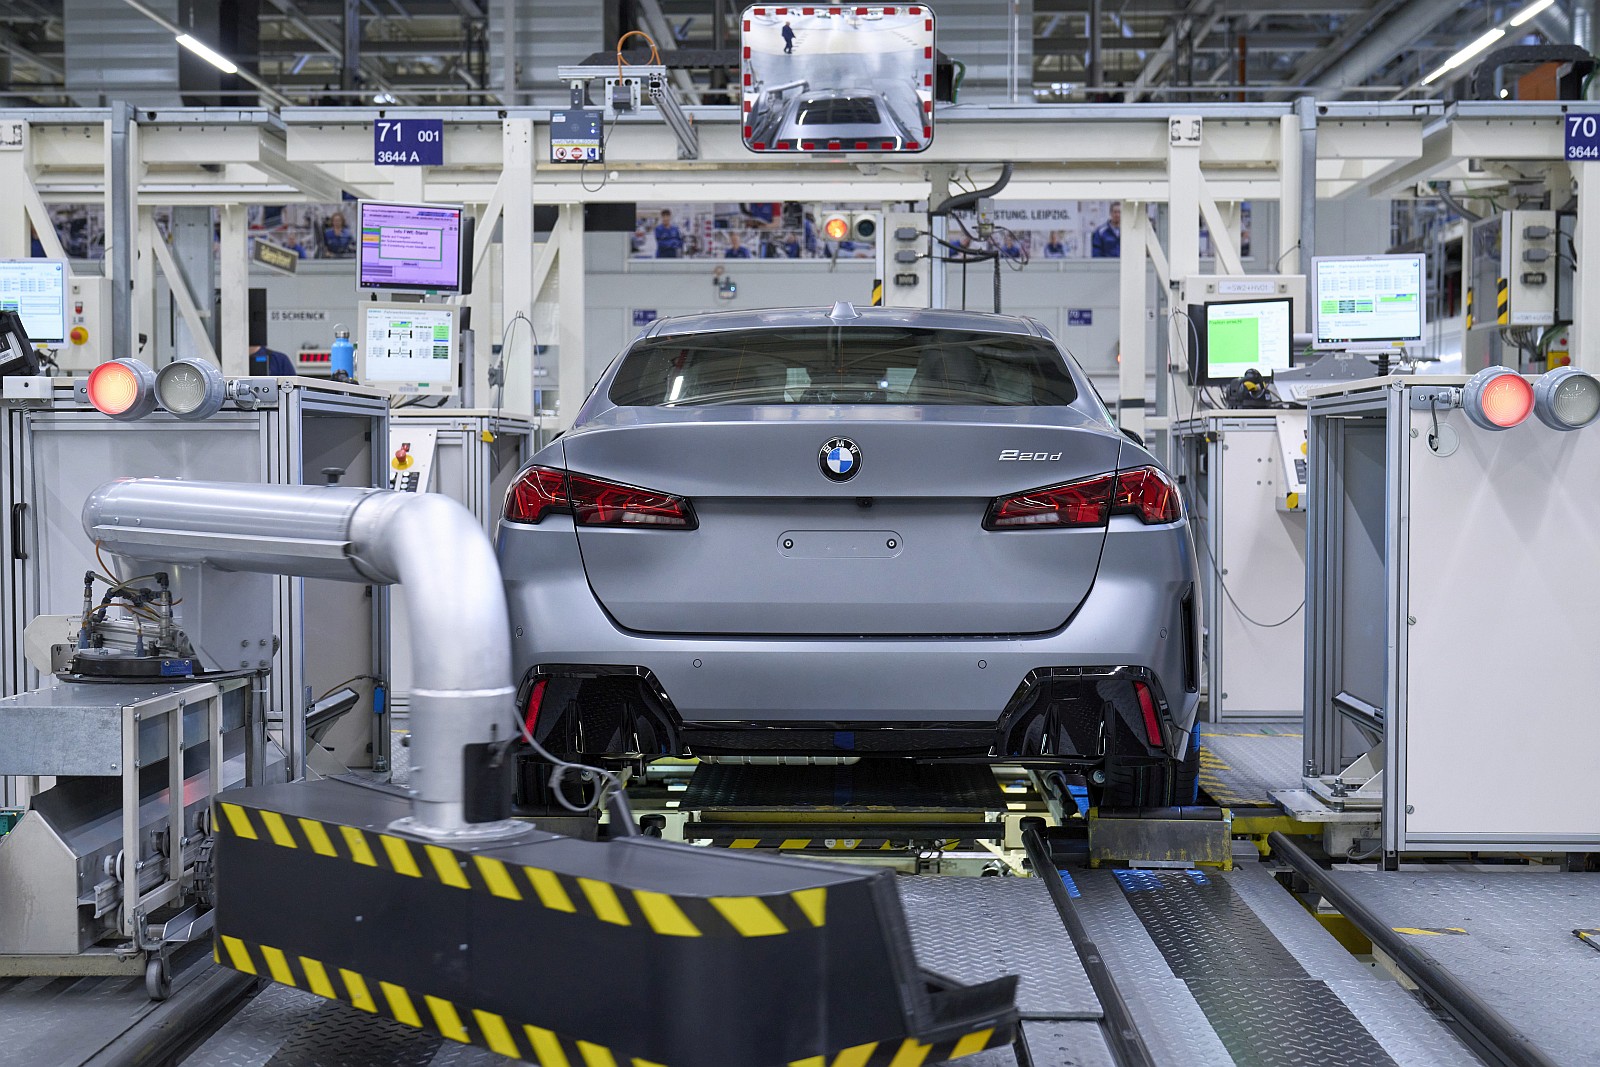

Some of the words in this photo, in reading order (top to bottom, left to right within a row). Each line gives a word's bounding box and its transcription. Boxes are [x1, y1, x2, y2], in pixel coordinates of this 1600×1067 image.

[377, 122, 402, 142] 71
[417, 130, 439, 142] 001
[1568, 116, 1597, 137] 70
[377, 150, 407, 163] 3644
[409, 150, 420, 163] A
[1568, 145, 1599, 158] 3644
[993, 209, 1029, 221] STUNG.
[1030, 209, 1071, 221] LEIPZIG.
[282, 310, 326, 321] SCHENCK
[822, 439, 858, 454] BMW
[998, 449, 1063, 461] 220d
